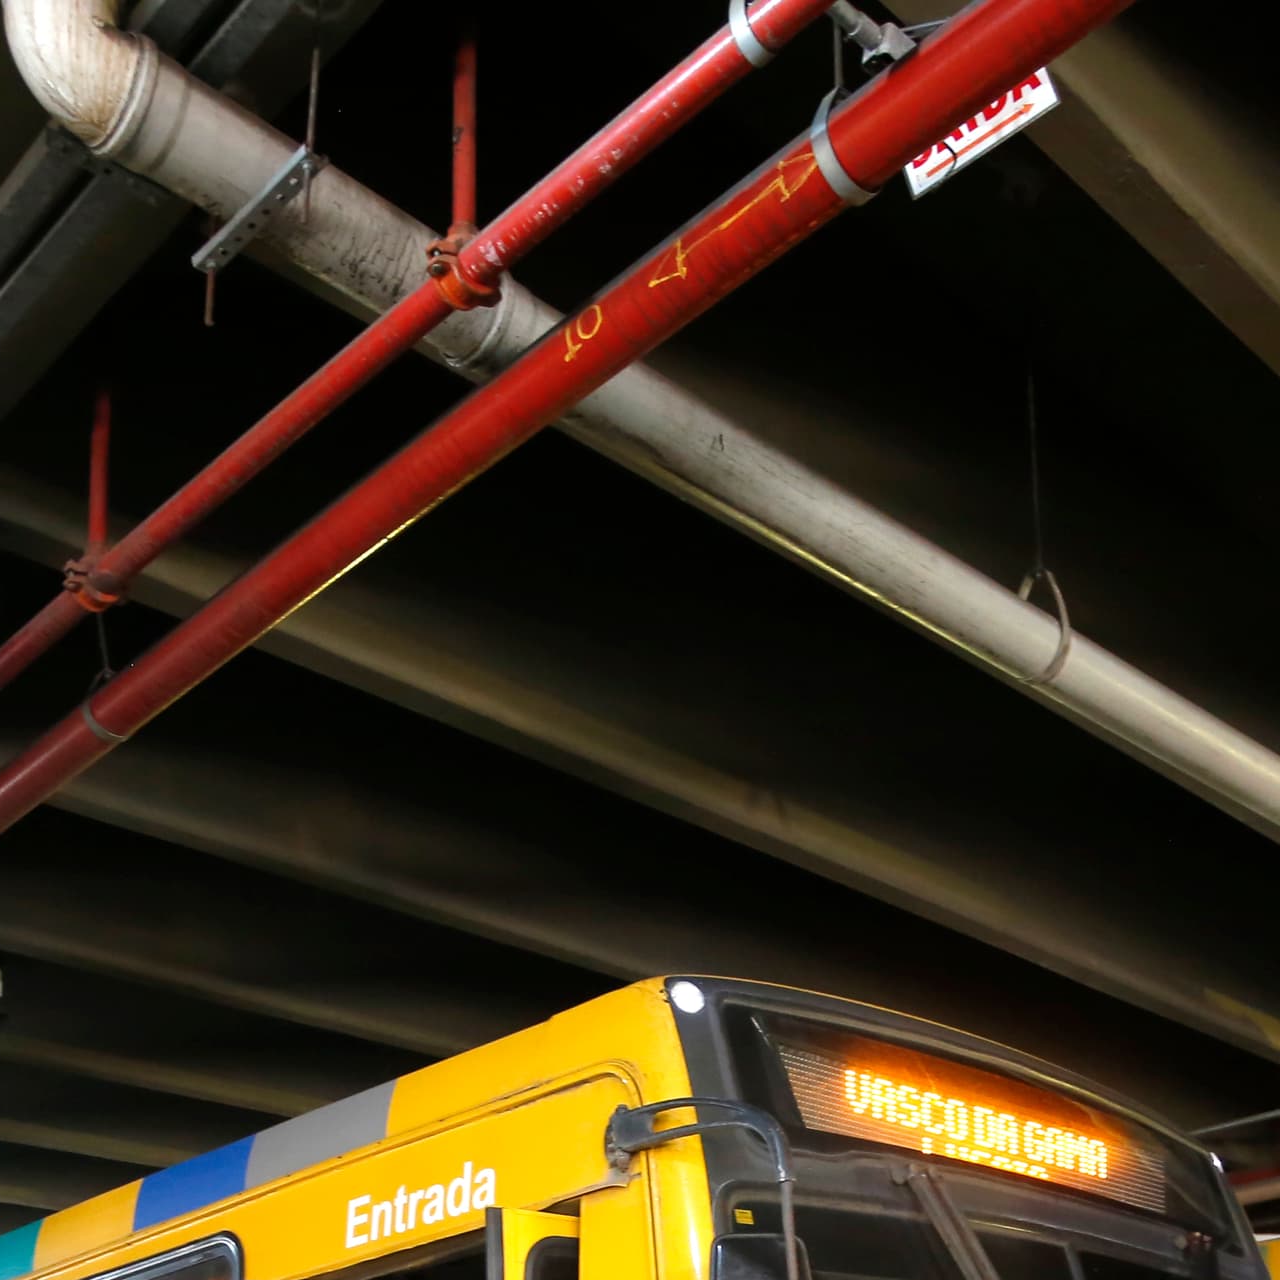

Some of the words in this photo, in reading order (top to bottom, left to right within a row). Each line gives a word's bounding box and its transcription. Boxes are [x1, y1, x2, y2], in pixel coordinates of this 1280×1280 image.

[843, 1069, 969, 1141] VASCO
[972, 1105, 1019, 1155] DA
[1022, 1120, 1108, 1179] GAMA
[345, 1160, 496, 1249] Entrada
